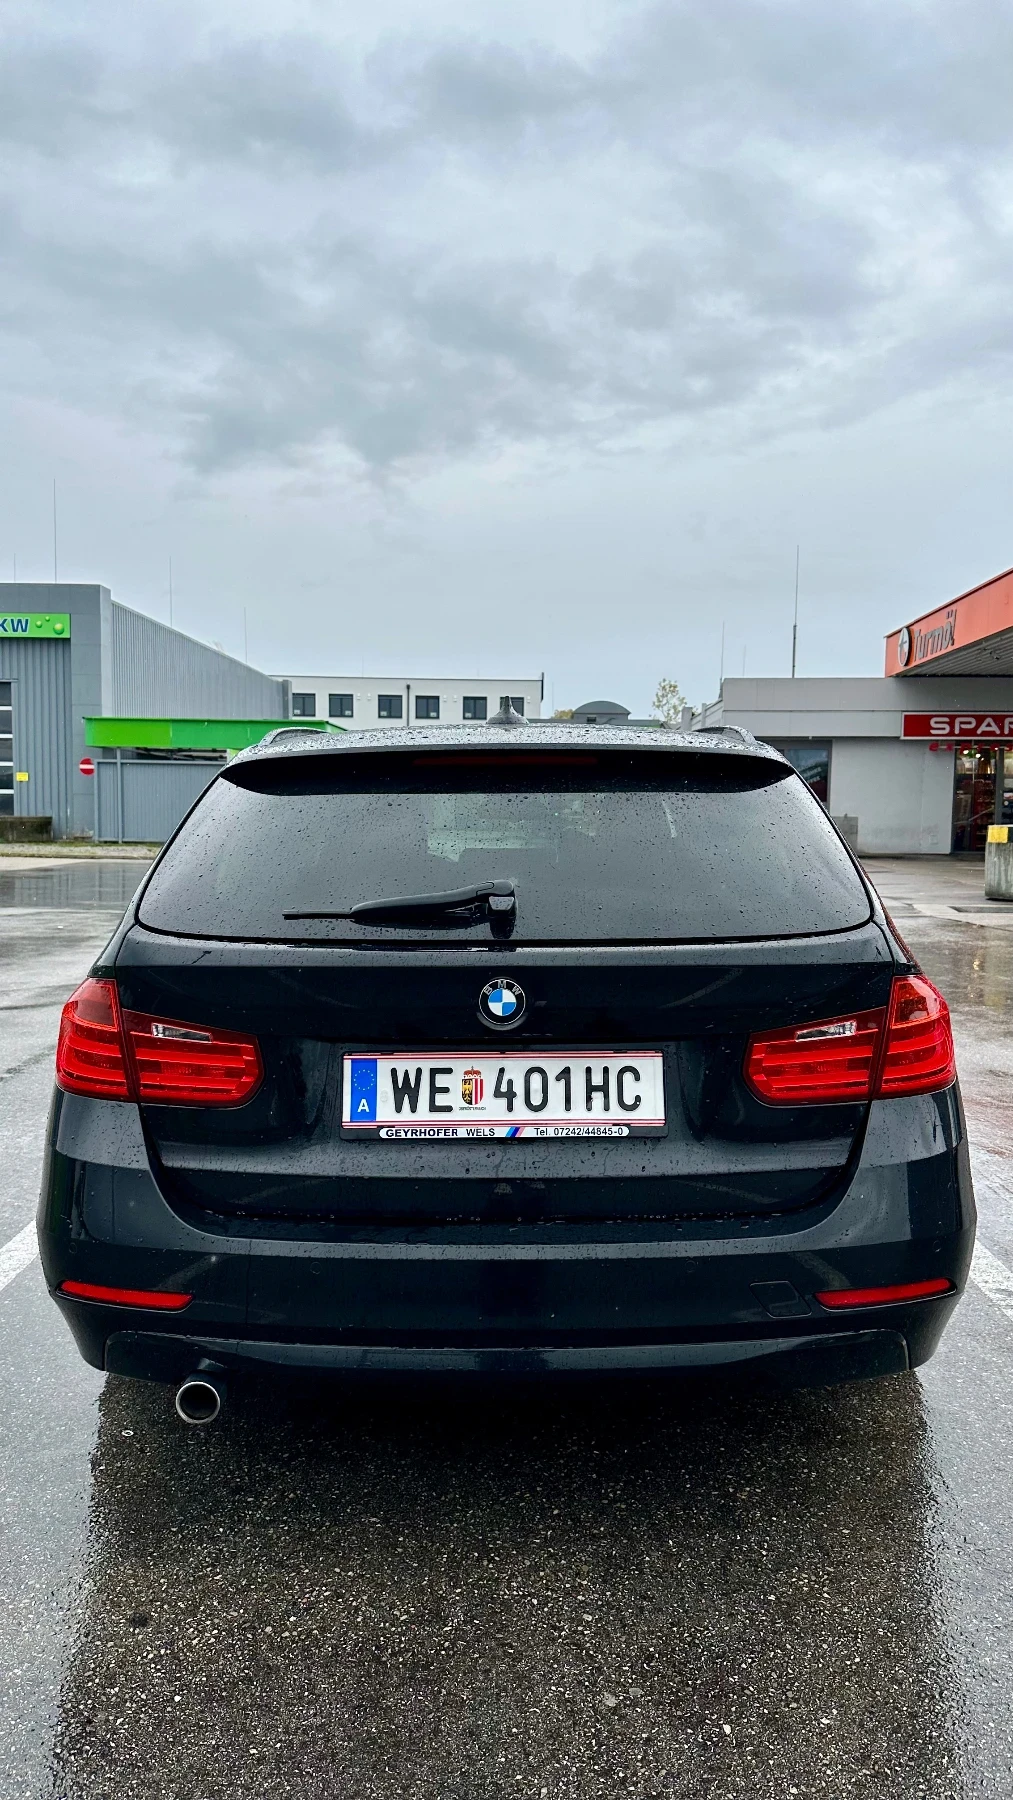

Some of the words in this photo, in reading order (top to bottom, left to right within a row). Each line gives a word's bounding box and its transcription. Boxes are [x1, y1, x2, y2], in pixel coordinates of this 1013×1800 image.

[914, 609, 957, 662] Turmöl
[483, 978, 522, 996] BMW
[390, 1067, 453, 1113] WE
[493, 1065, 641, 1112] 401HC
[357, 1098, 370, 1113] A
[385, 1128, 458, 1137] GEYRHOFER
[466, 1127, 496, 1137] WELS
[534, 1127, 551, 1136] Tel.
[553, 1127, 624, 1136] 07242/44845-0
